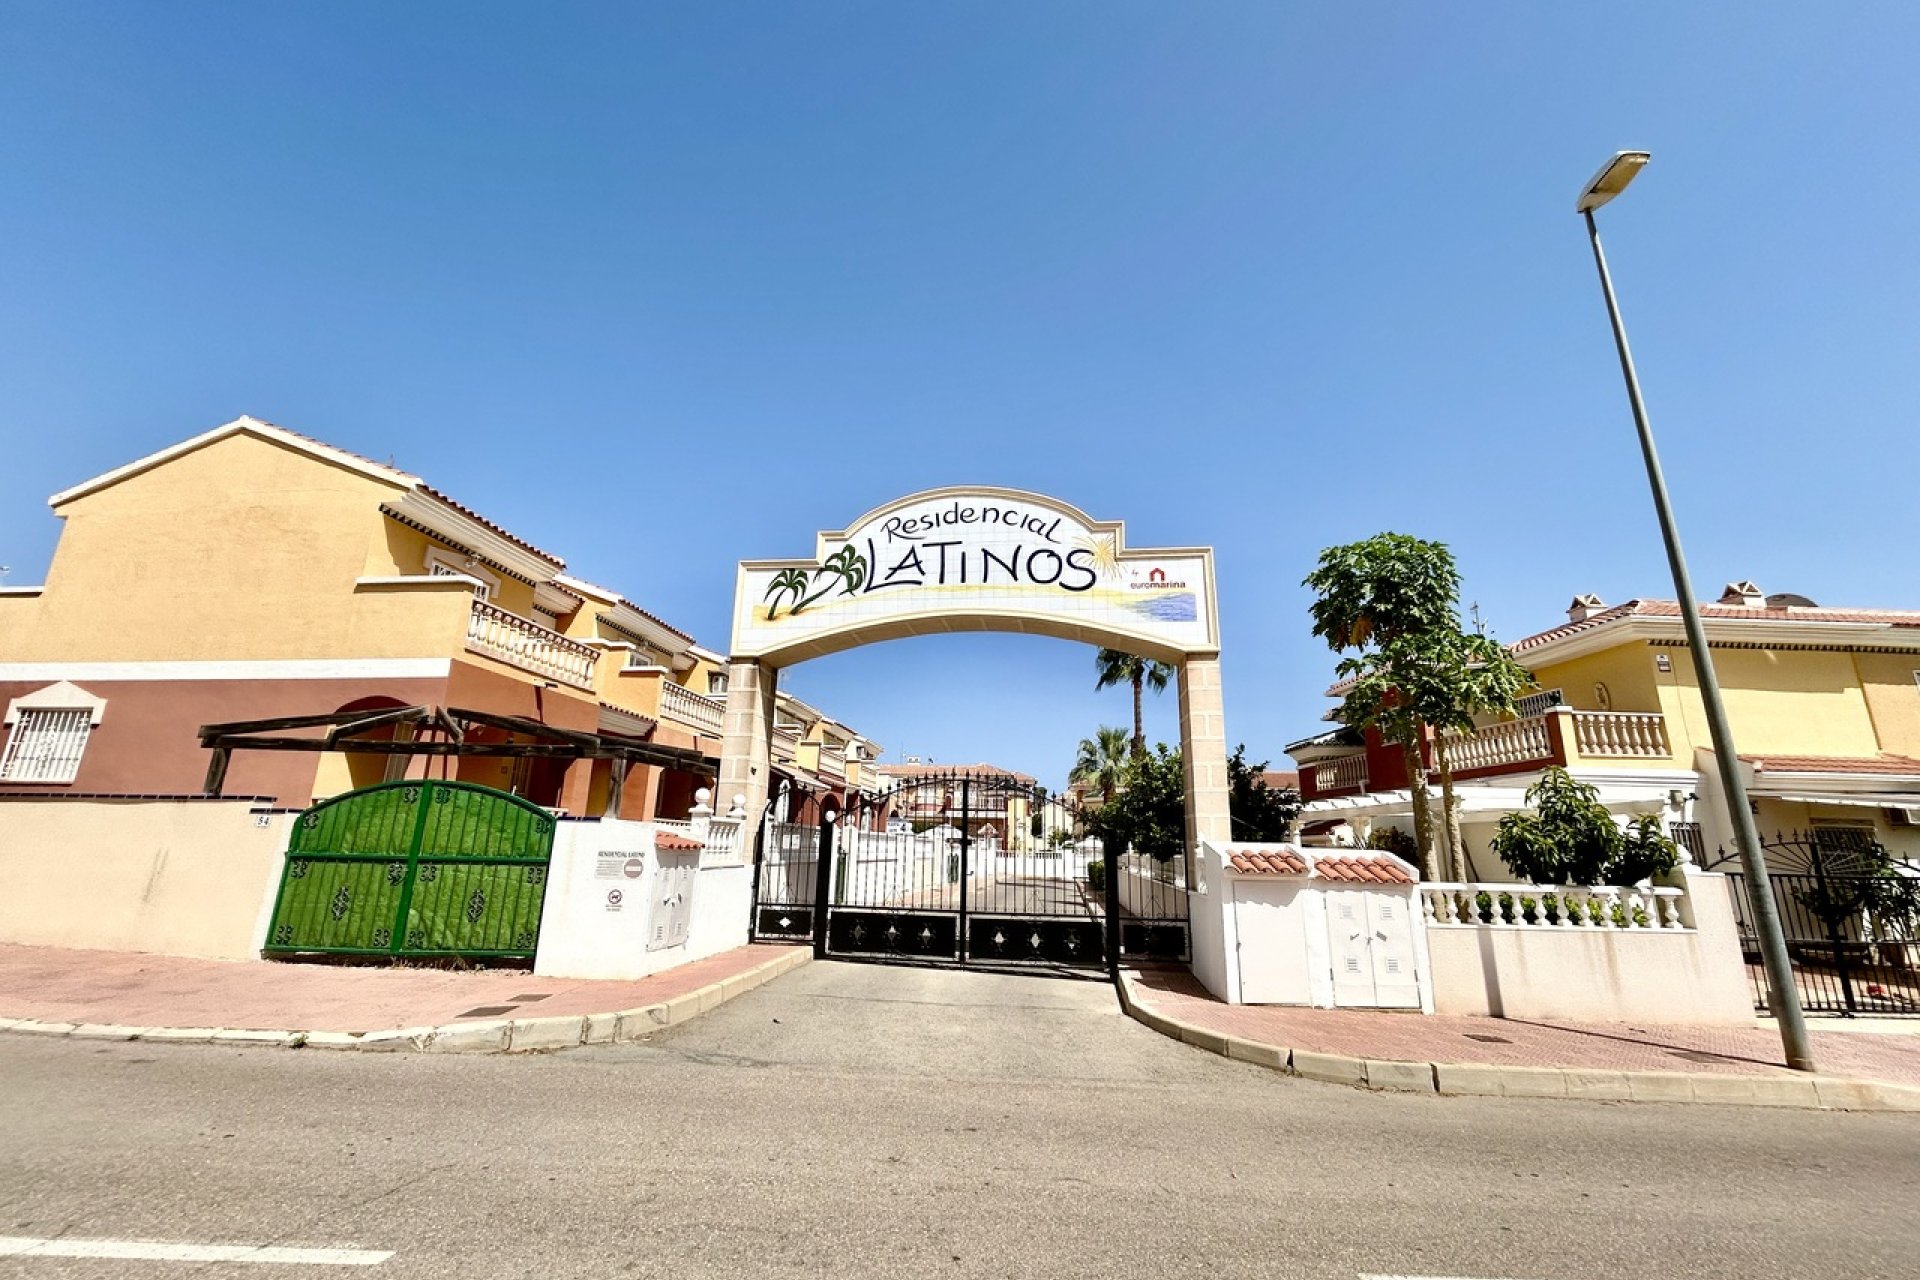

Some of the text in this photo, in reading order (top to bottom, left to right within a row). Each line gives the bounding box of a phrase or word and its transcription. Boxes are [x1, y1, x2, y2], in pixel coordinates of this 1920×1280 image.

[880, 502, 1061, 543] Residencial
[863, 538, 1097, 592] LATINOS
[1130, 581, 1186, 589] euromarina
